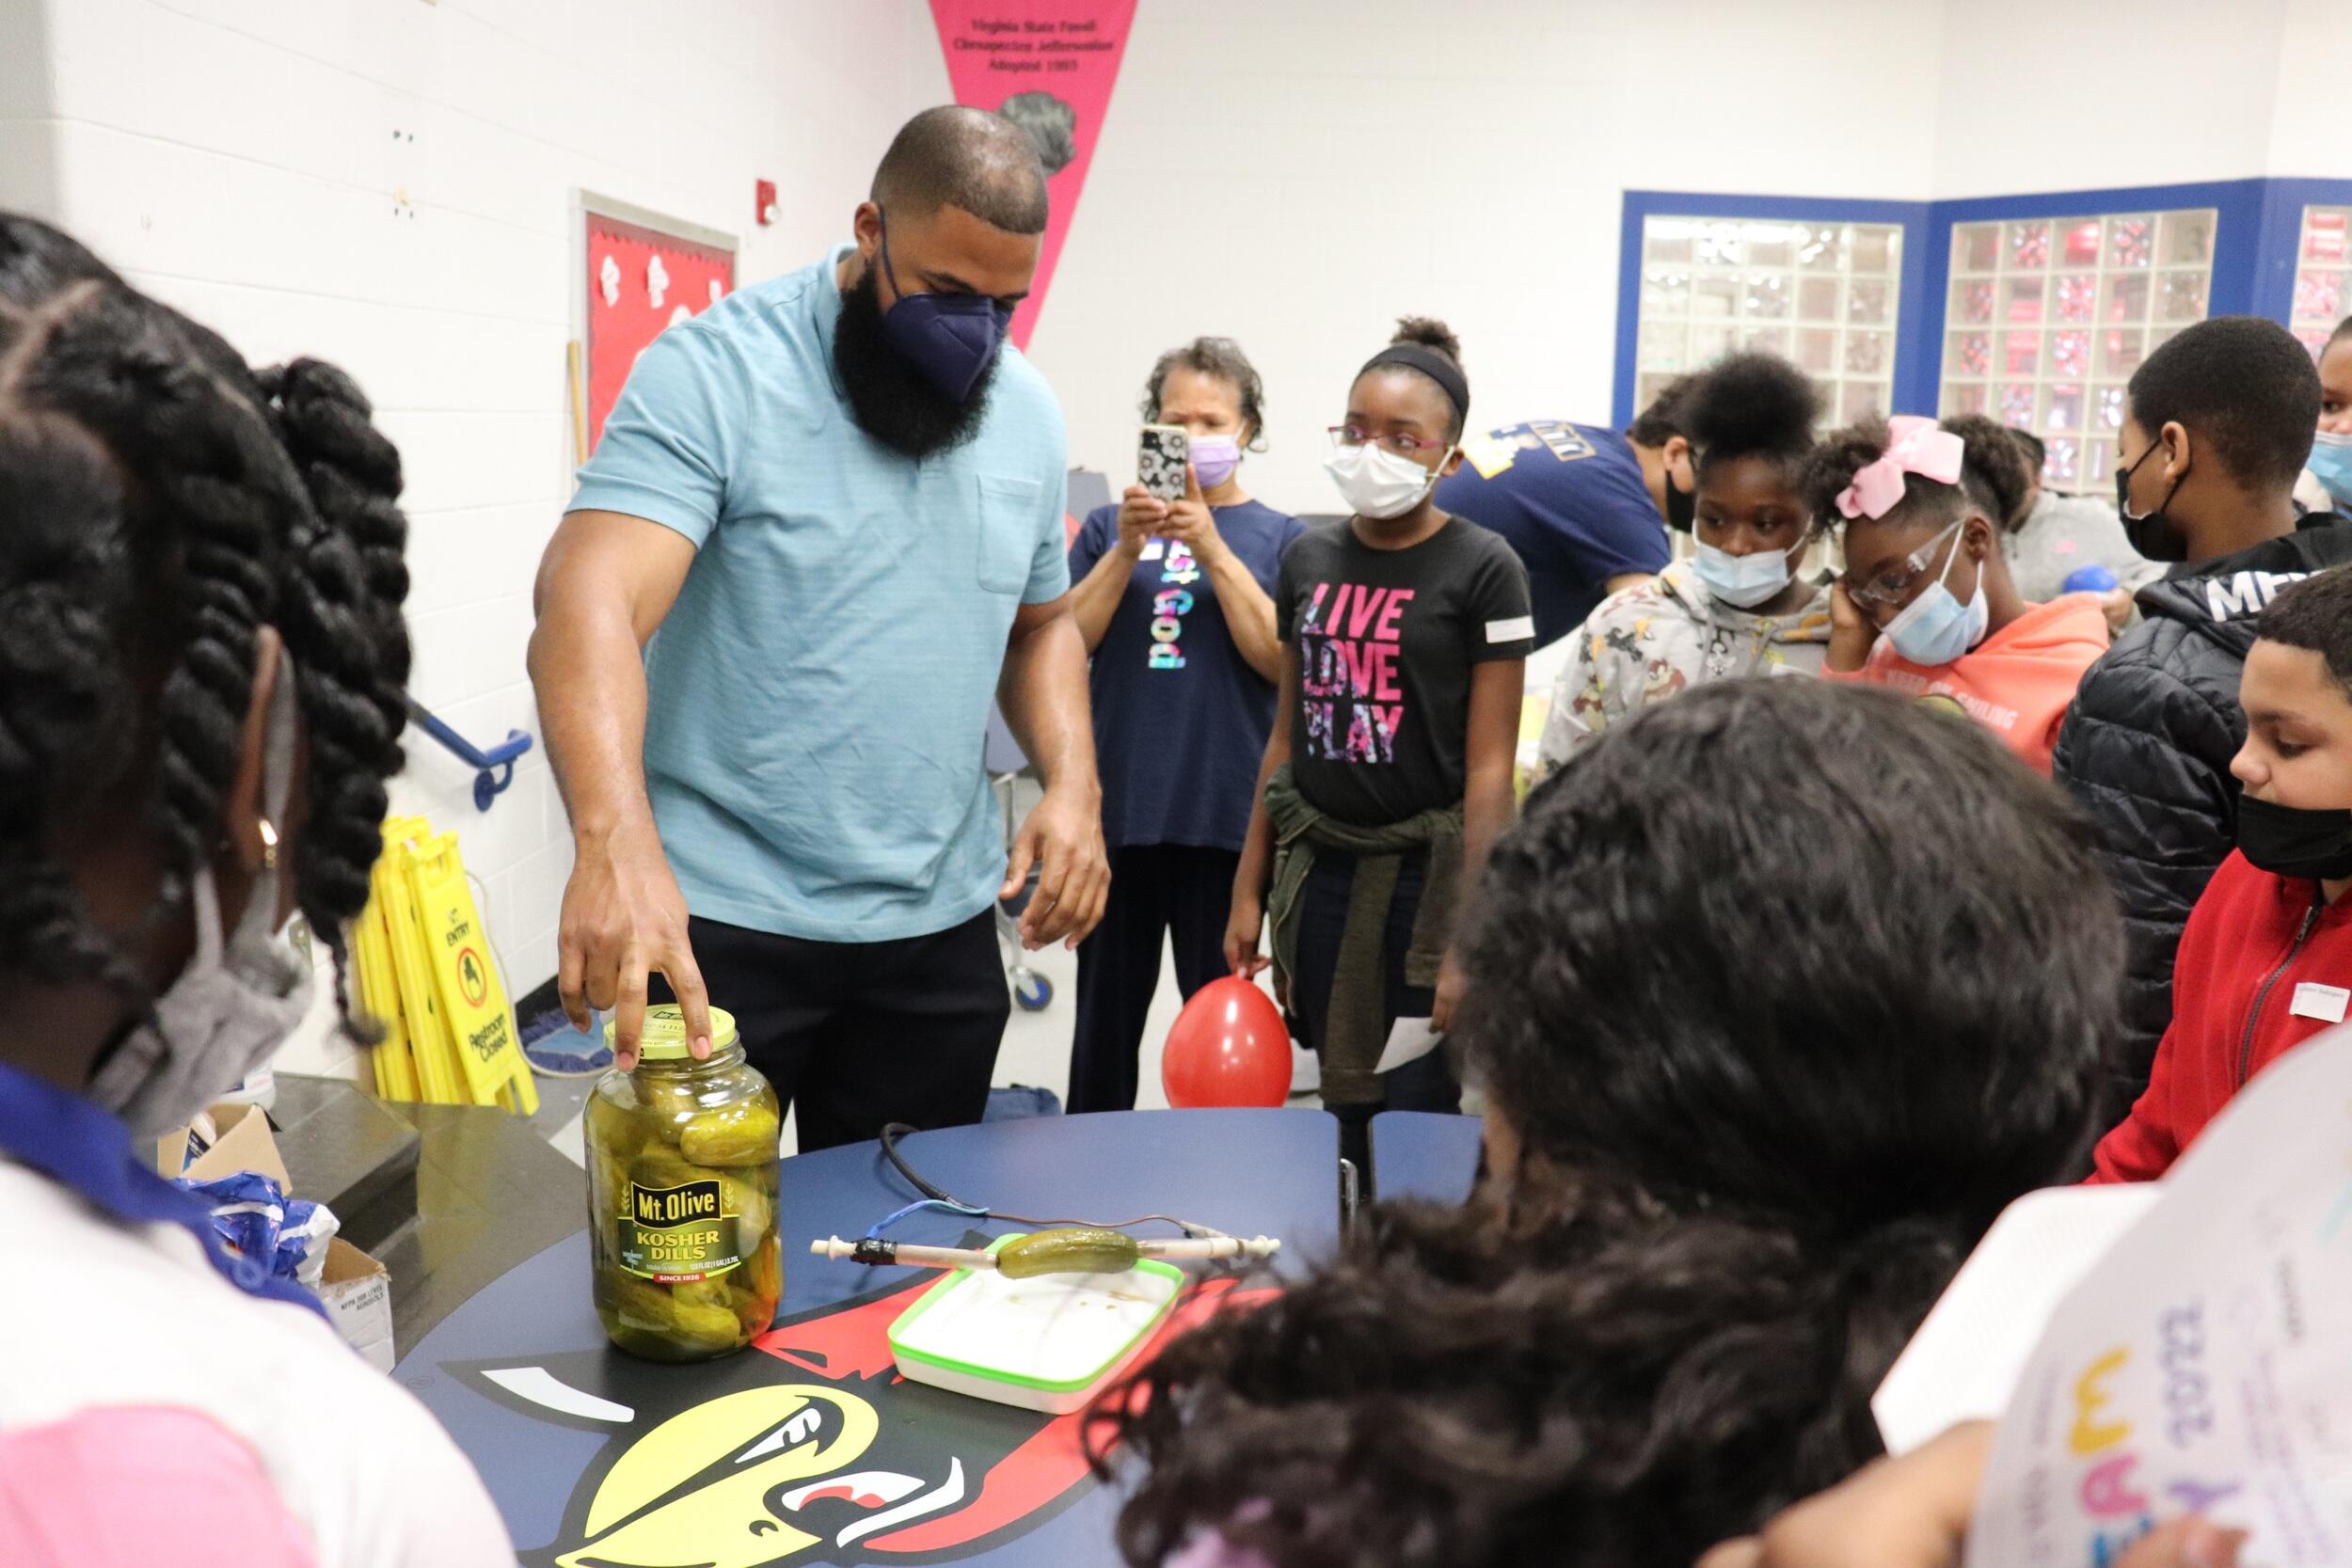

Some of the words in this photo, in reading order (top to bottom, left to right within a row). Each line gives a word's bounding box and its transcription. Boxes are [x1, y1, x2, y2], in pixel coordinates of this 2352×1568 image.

[972, 19, 1019, 35] Virginia
[1024, 21, 1055, 33] State
[990, 59, 1041, 72] Adopted
[1301, 582, 1415, 641] LIVE
[1148, 589, 1193, 669] God
[1302, 635, 1402, 702] LOVE
[1304, 701, 1405, 764] PLAY
[446, 922, 469, 947] ENTRY
[469, 1013, 506, 1052] Restroom
[480, 1030, 508, 1063] Closed
[639, 1192, 664, 1221] Mt.
[666, 1190, 715, 1220] Olive
[637, 1230, 721, 1247] KOSHER
[651, 1246, 707, 1260] DILLS
